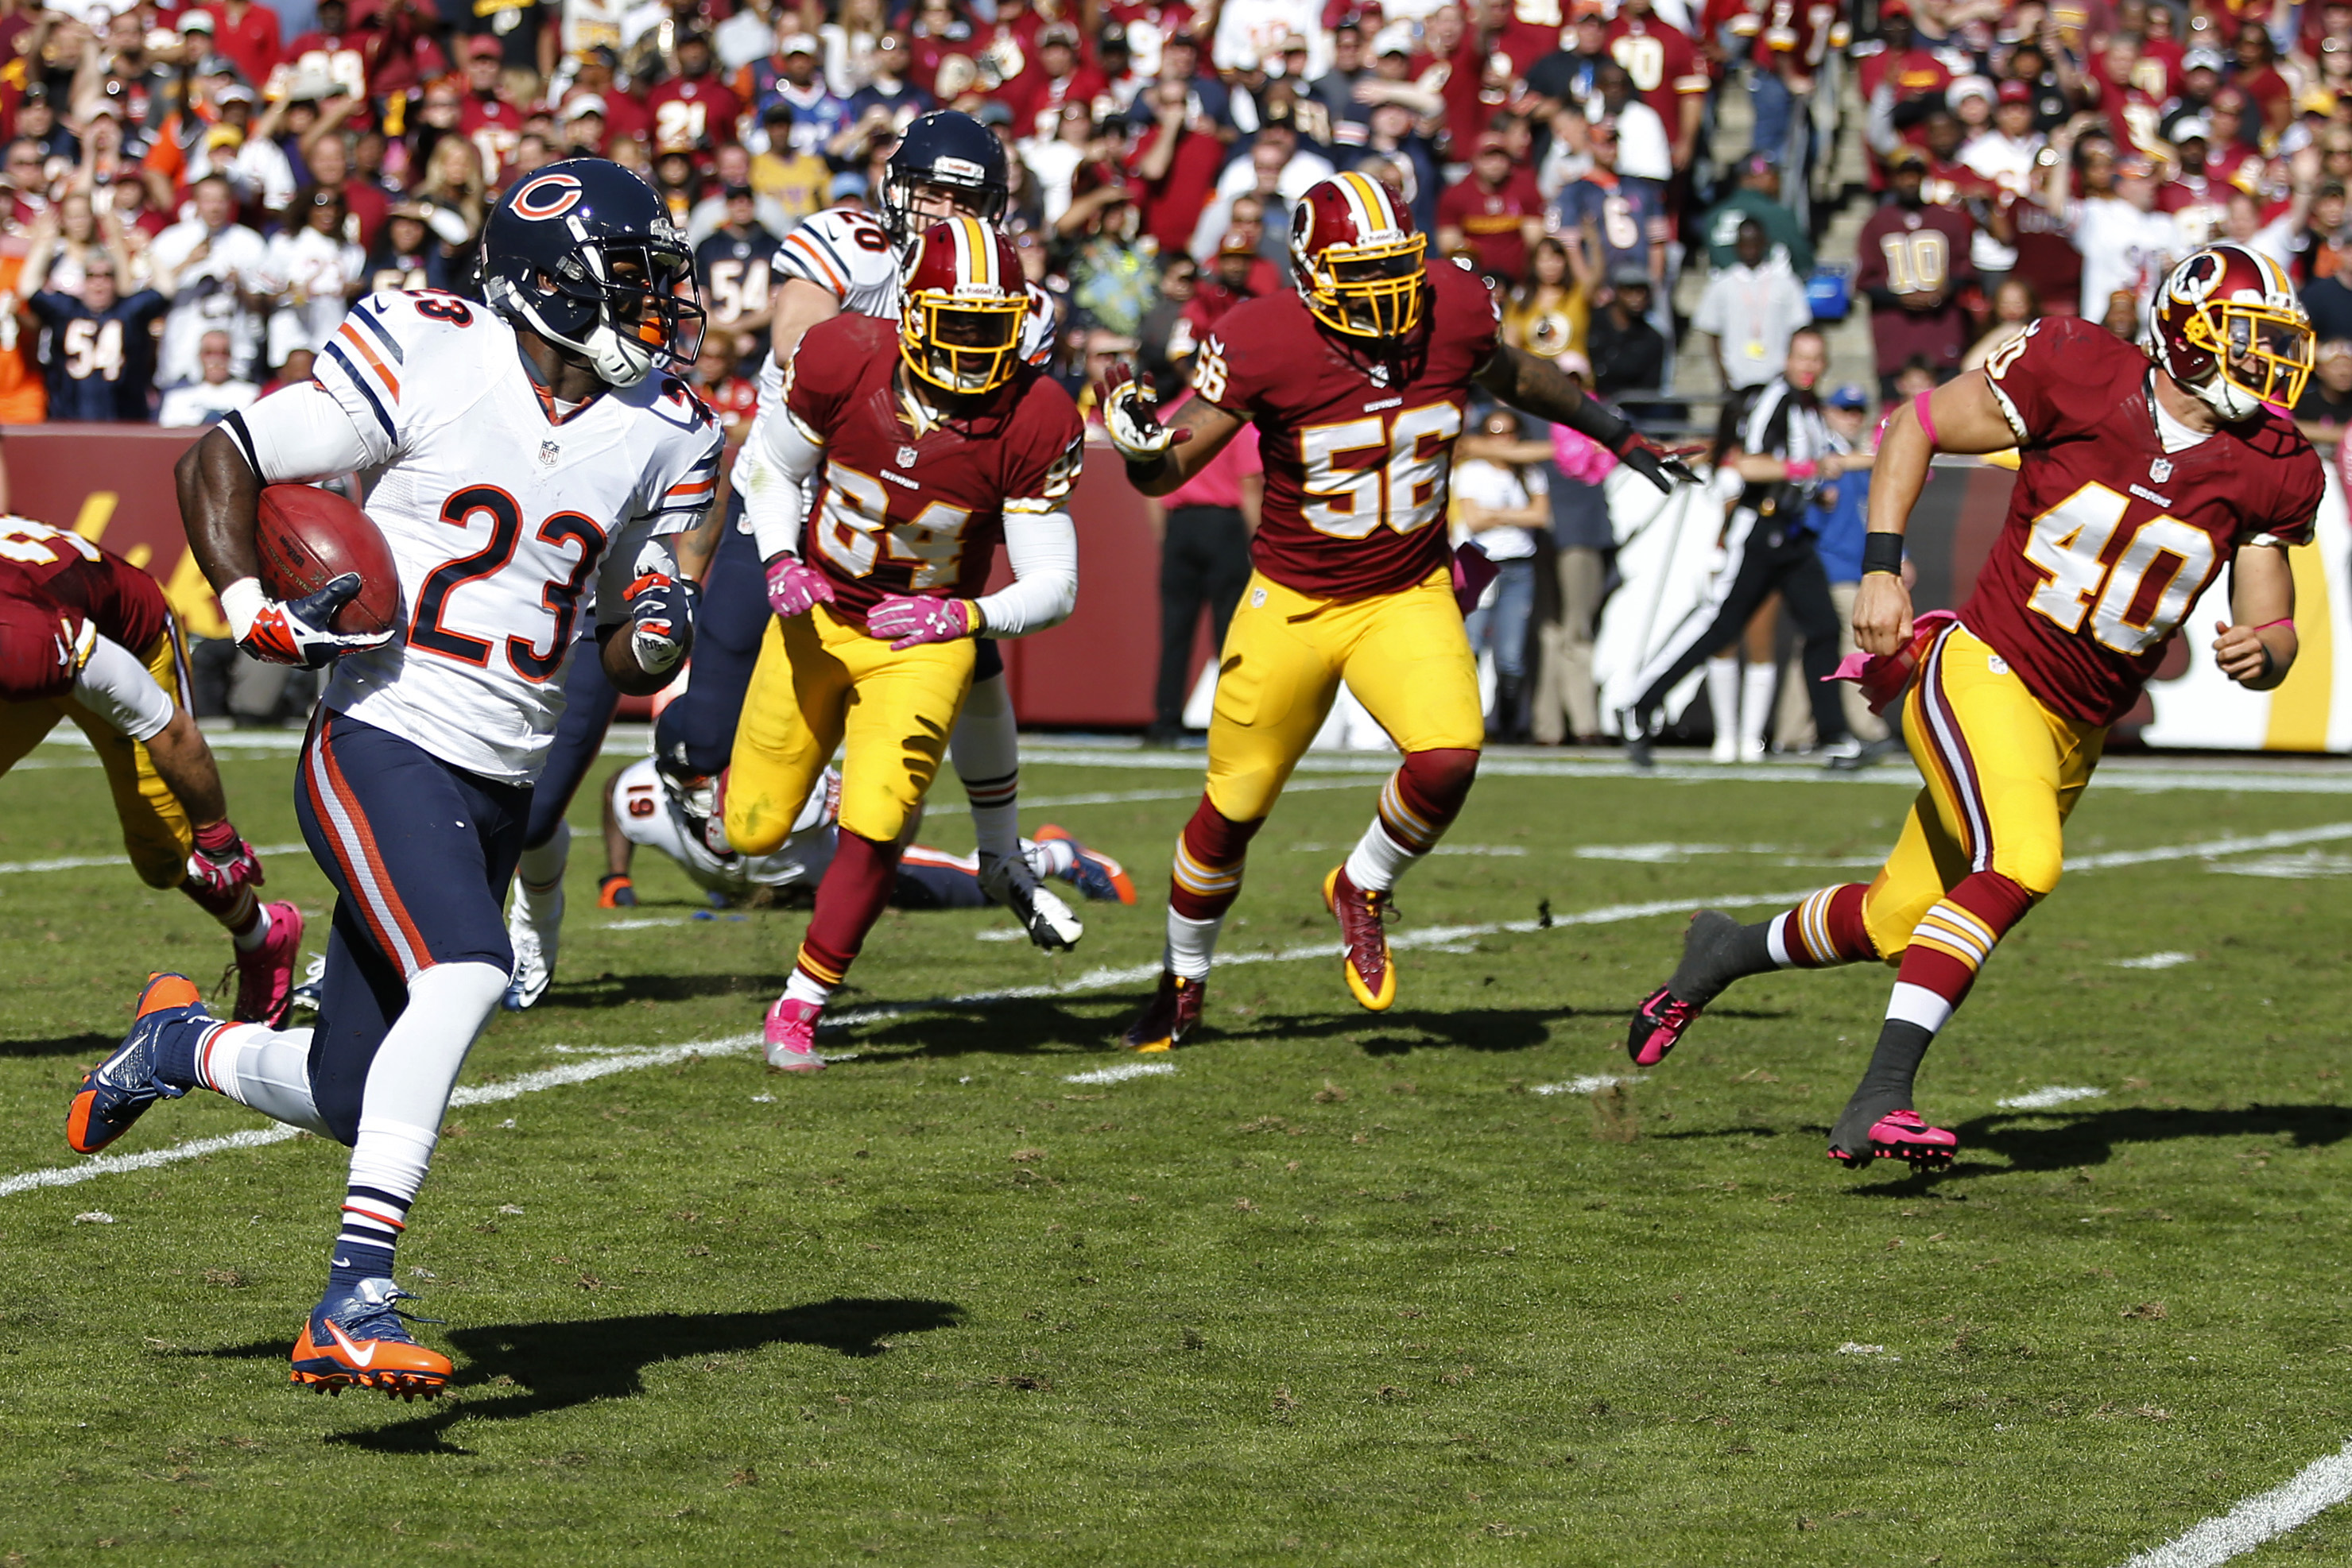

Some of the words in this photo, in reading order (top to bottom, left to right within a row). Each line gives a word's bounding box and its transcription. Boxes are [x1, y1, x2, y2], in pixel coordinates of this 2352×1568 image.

[710, 258, 769, 324] 54
[1880, 229, 1948, 295] 10
[401, 288, 475, 329] 3
[64, 318, 124, 381] 54
[1192, 339, 1228, 403] 56
[1300, 399, 1463, 540] 56
[816, 459, 973, 590] 84
[406, 483, 608, 684] 23
[2023, 480, 2217, 656] 40
